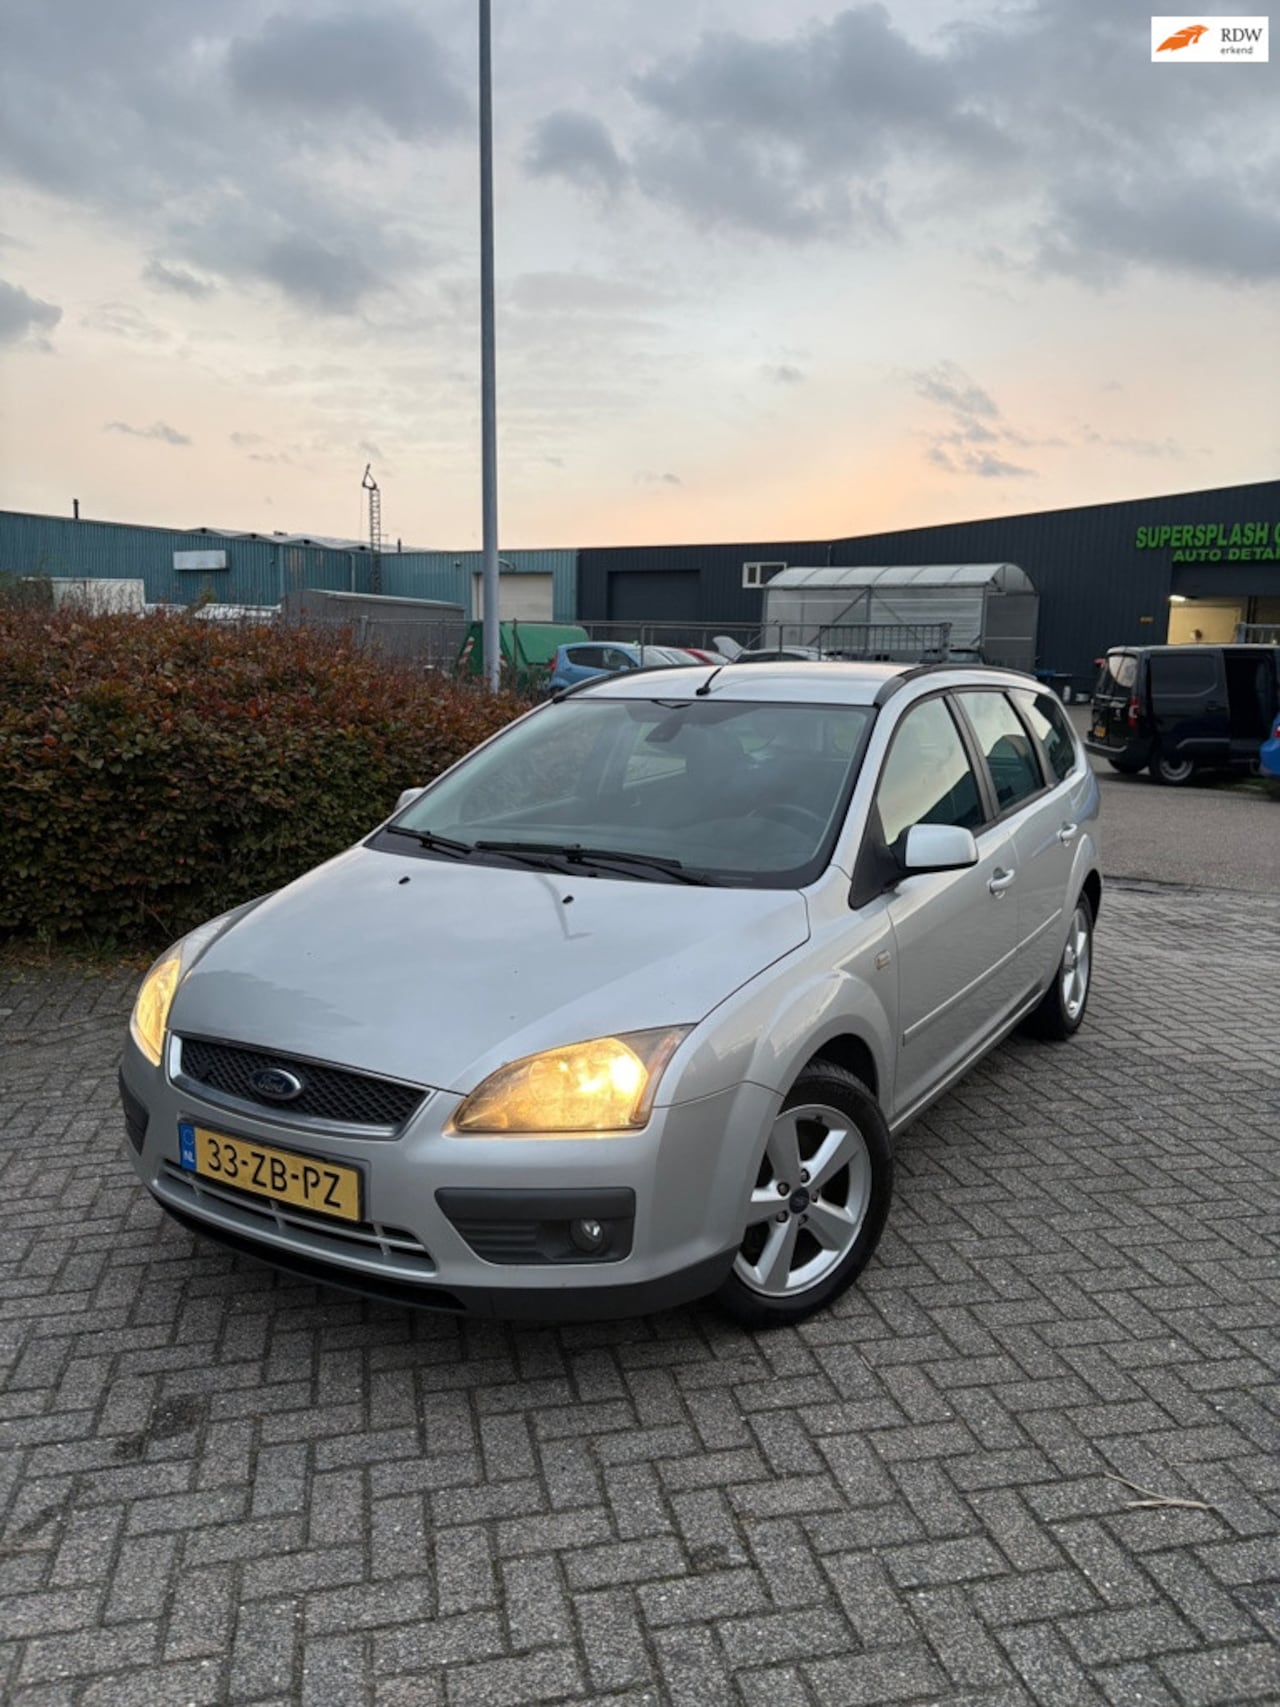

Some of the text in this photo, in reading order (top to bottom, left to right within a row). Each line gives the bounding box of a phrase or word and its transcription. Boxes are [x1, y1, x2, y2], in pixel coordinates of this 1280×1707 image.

[1136, 521, 1269, 548] SUPERSPLASH
[1172, 548, 1222, 562] AUTO
[256, 1073, 288, 1093] Ford
[183, 1150, 195, 1163] NL
[207, 1138, 341, 1208] 33-ZB-PZ
